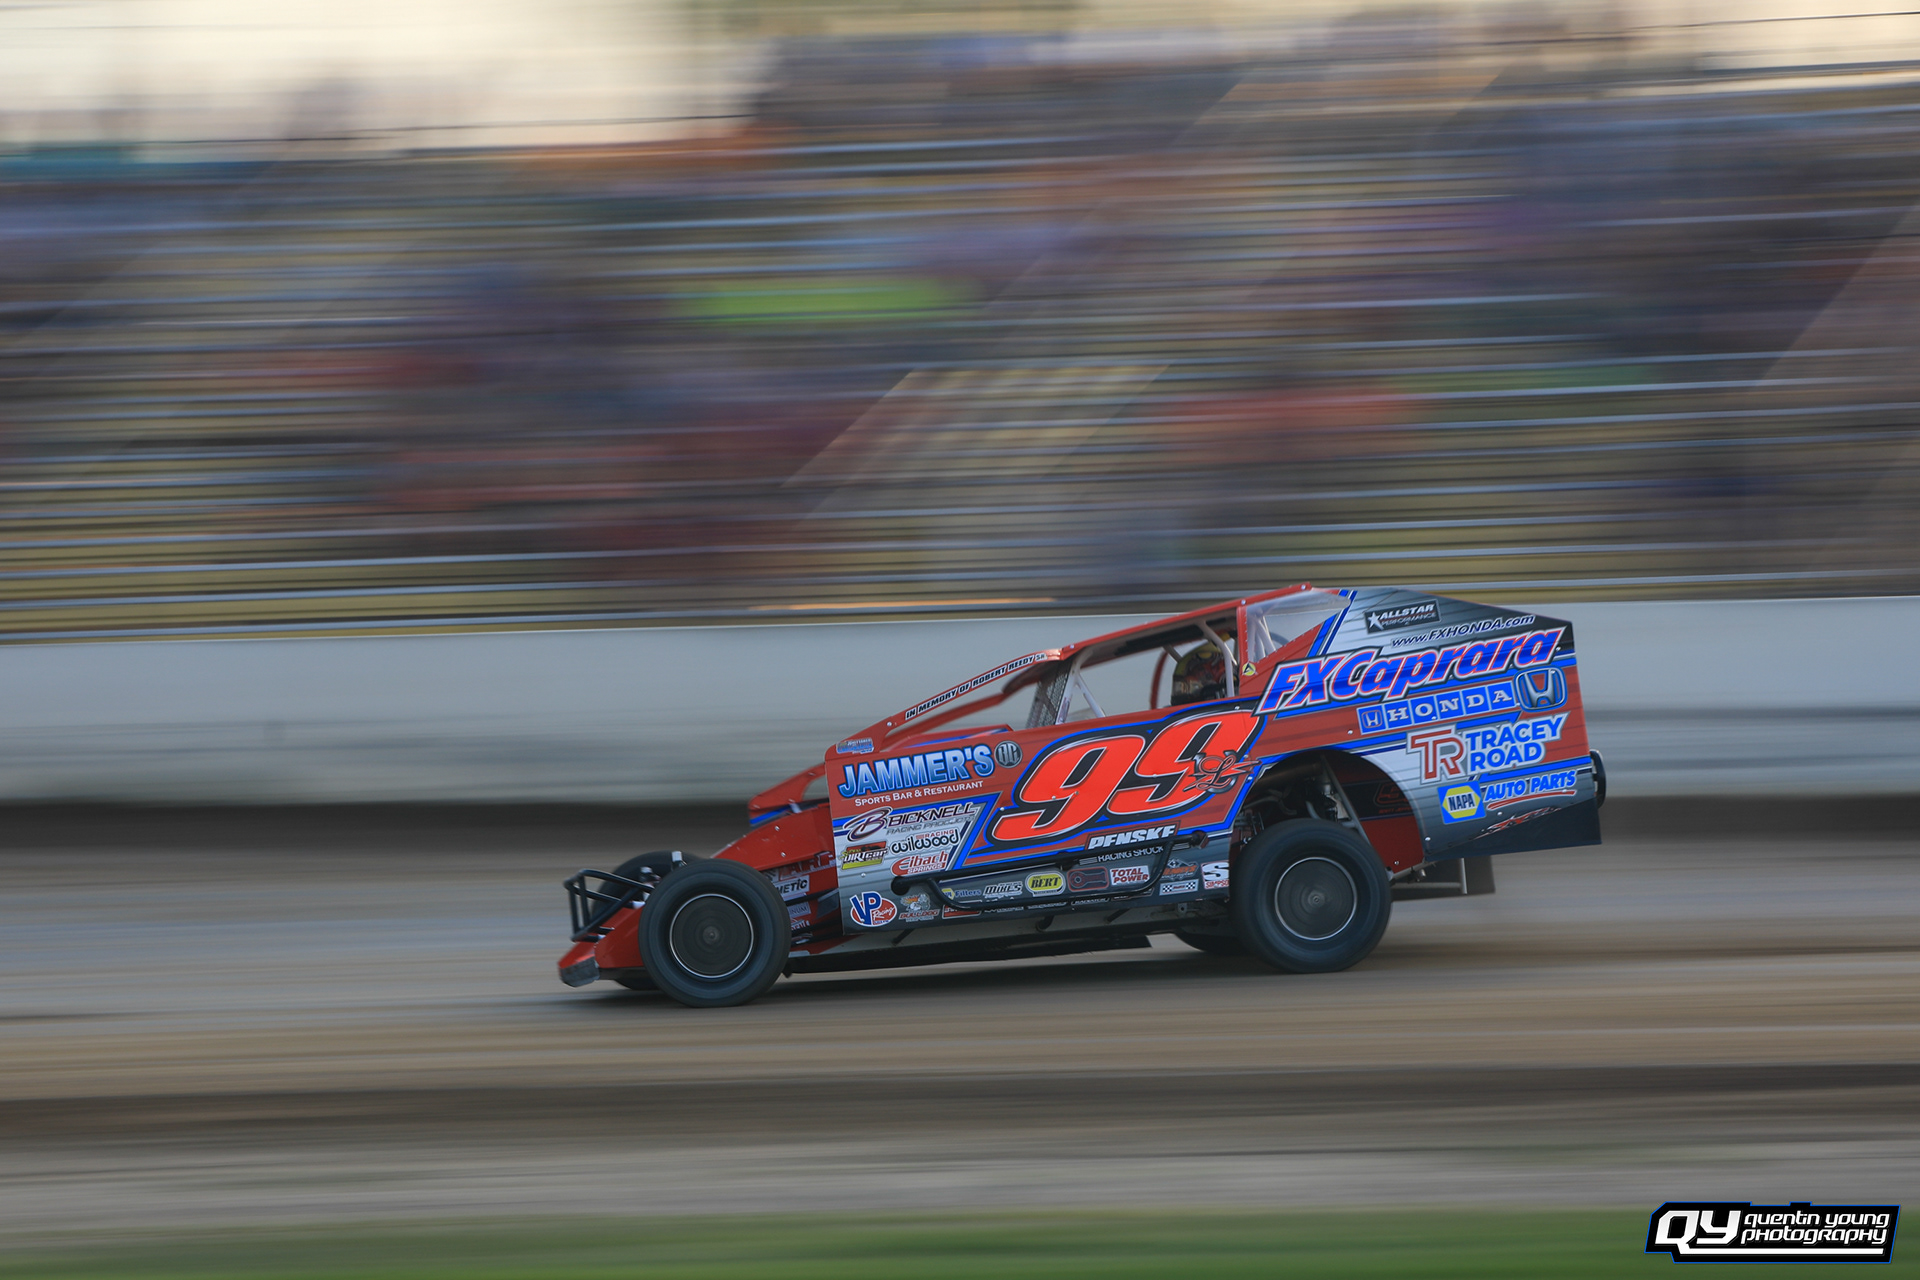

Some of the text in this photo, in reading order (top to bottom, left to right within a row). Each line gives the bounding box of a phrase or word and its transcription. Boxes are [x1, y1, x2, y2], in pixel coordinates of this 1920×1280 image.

[1379, 603, 1436, 620] ALLSTAR
[1391, 614, 1535, 647] www.FXHONDA.com
[1258, 628, 1566, 713] FXCaprara
[906, 709, 917, 719] IN
[918, 689, 957, 713] MEMORY
[960, 684, 970, 693] OF
[973, 667, 1007, 687] ROBERT
[1008, 656, 1034, 671] REEDY
[1387, 689, 1512, 722] HONDA
[1465, 716, 1563, 751] TRACEY
[1410, 729, 1465, 780] TR
[1470, 742, 1542, 772] ROAD
[838, 744, 995, 798] JAMMER'S
[991, 710, 1261, 841] 99
[915, 789, 922, 798] &
[1485, 771, 1576, 801] AUTO PARTS
[1448, 792, 1475, 811] NAPA
[886, 813, 976, 836] RACING PRODUCTS
[888, 802, 976, 827] BICKNELL
[891, 829, 959, 854] wilwood
[925, 829, 954, 839] RACING
[891, 851, 948, 876] Eibach
[907, 863, 942, 874] SPRINGS
[1097, 851, 1132, 862] RACING
[1031, 877, 1061, 889] BERT
[1111, 868, 1143, 878] TOTAL
[1114, 874, 1149, 883] POWER
[955, 889, 982, 898] Filters
[850, 891, 882, 925] VP
[872, 906, 895, 920] Racing
